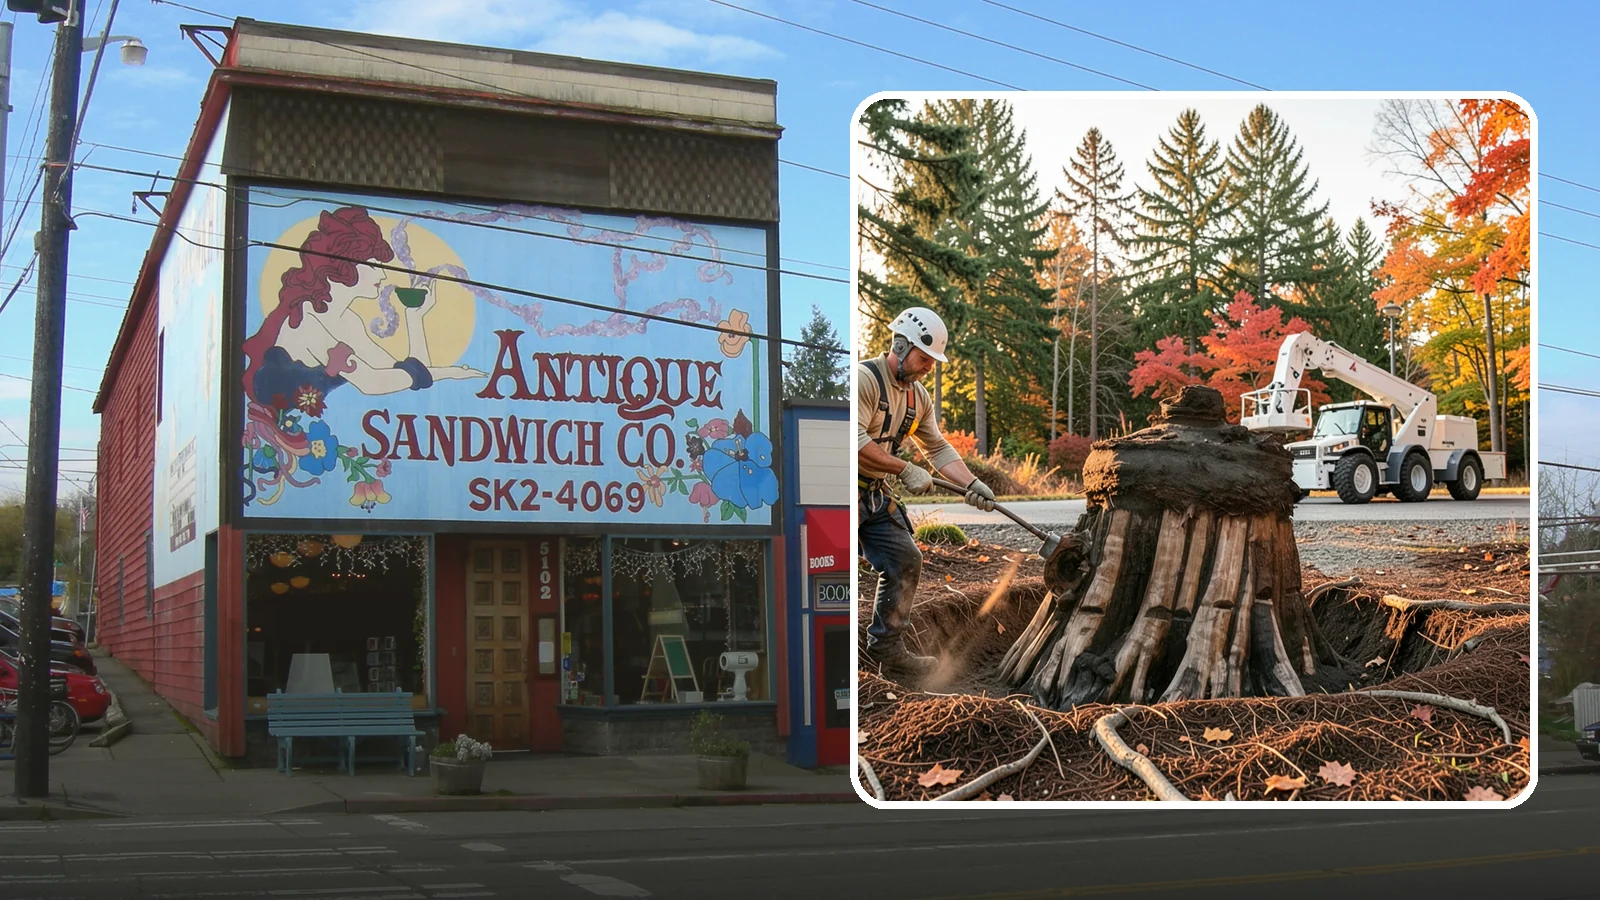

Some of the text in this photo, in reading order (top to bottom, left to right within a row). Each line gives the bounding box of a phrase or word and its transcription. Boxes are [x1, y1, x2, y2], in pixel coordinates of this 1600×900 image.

[475, 329, 724, 420] ANTIQUE
[361, 408, 685, 469] SANDWICH CO.
[468, 476, 645, 512] SK2-4069
[539, 541, 552, 600] 5102
[809, 555, 835, 569] BOOKS
